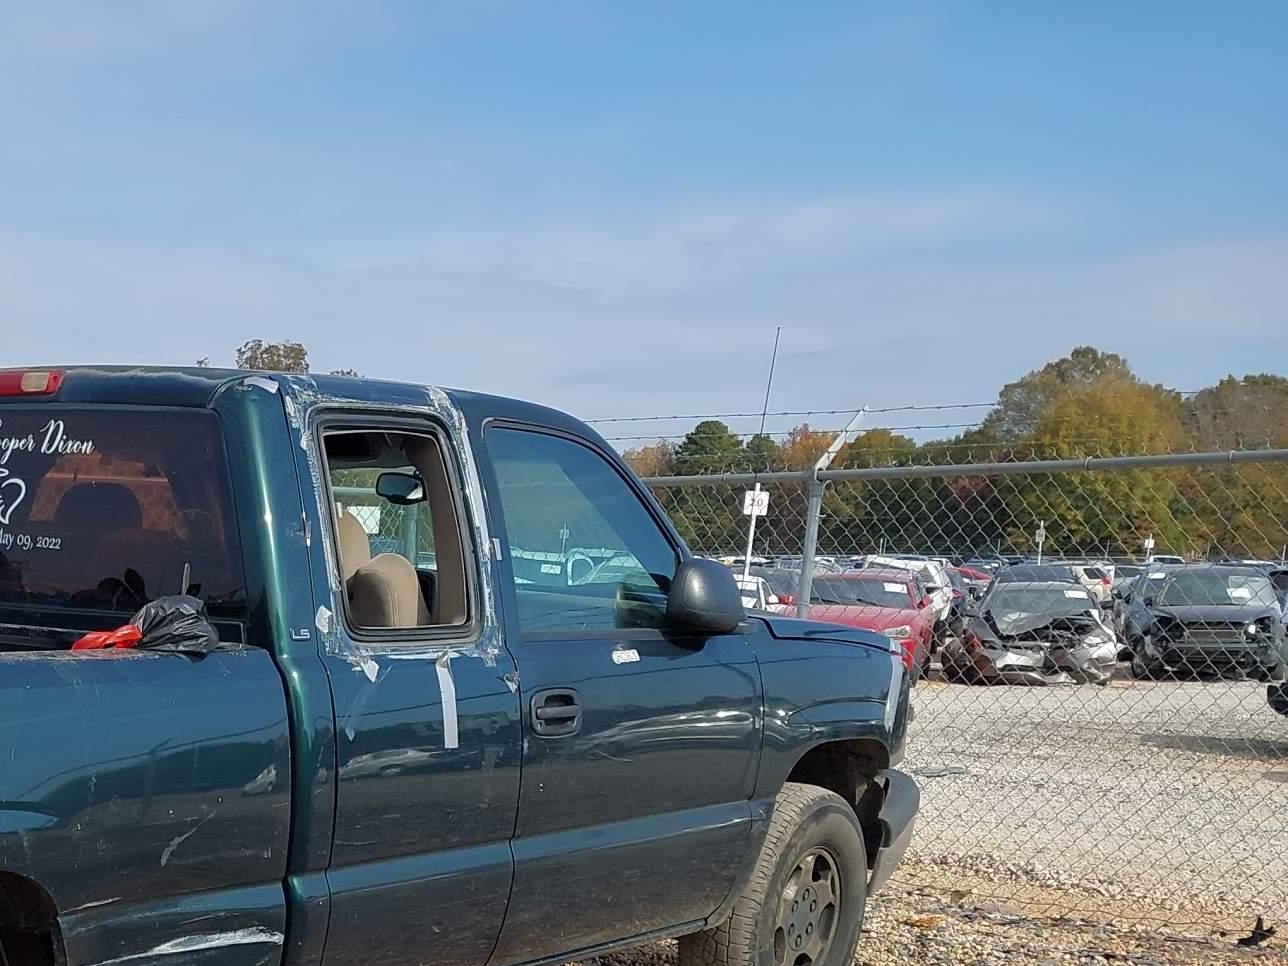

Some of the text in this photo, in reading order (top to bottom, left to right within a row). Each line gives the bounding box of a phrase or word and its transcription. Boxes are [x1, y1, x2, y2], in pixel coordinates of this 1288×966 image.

[39, 419, 96, 455] Dixon
[16, 536, 34, 550] 09,
[35, 535, 62, 550] 2022
